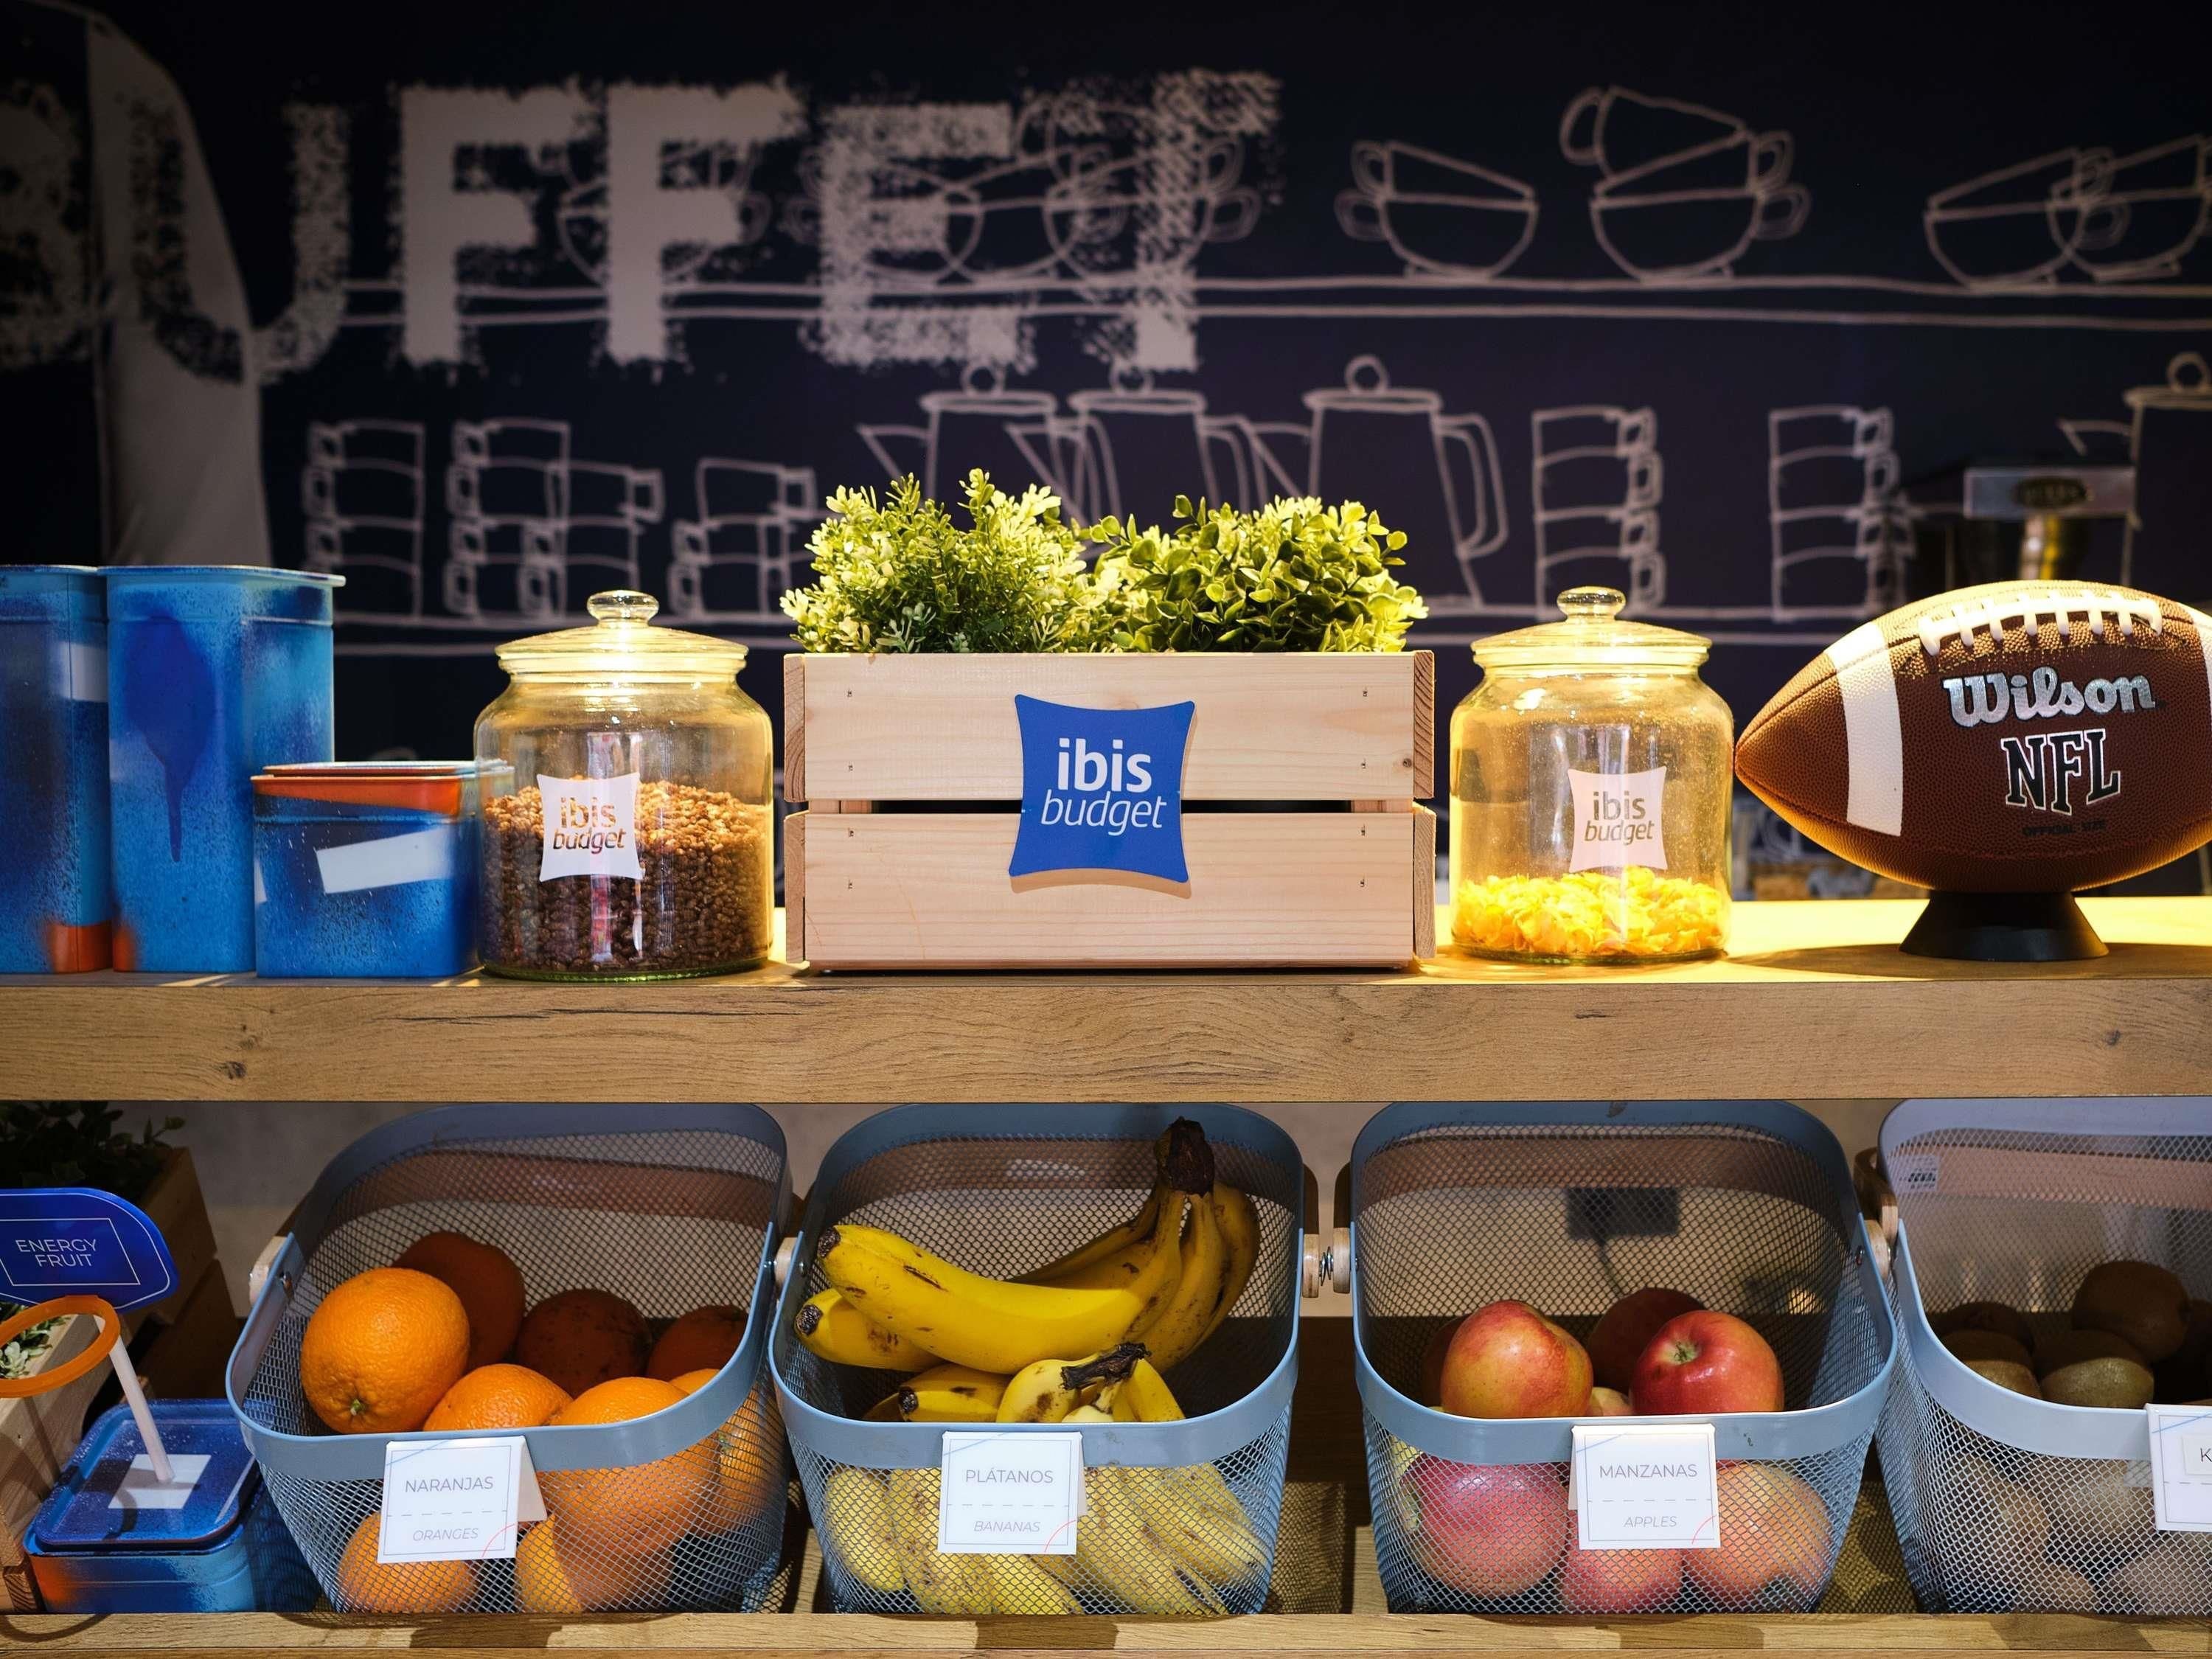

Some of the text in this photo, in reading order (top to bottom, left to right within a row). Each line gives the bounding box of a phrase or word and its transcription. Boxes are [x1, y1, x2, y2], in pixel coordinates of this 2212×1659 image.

[1942, 665, 2157, 728] Wilson
[1057, 737, 1152, 793] ibis
[2000, 728, 2121, 815] NFL
[560, 796, 618, 829] ibis
[1040, 789, 1167, 836] budget
[1593, 790, 1646, 821] ibis
[552, 826, 627, 854] budget
[1584, 819, 1656, 846] budget
[15, 1239, 97, 1252] ENERGY
[35, 1254, 92, 1267] FRUIT
[965, 1467, 1054, 1484] PLÁTANOS
[1599, 1464, 1698, 1478] MANZANAS
[405, 1476, 494, 1492] NARANJAS
[973, 1520, 1040, 1532] BANANAS
[1623, 1516, 1677, 1528] APPLES
[412, 1528, 479, 1541] ORANGES
